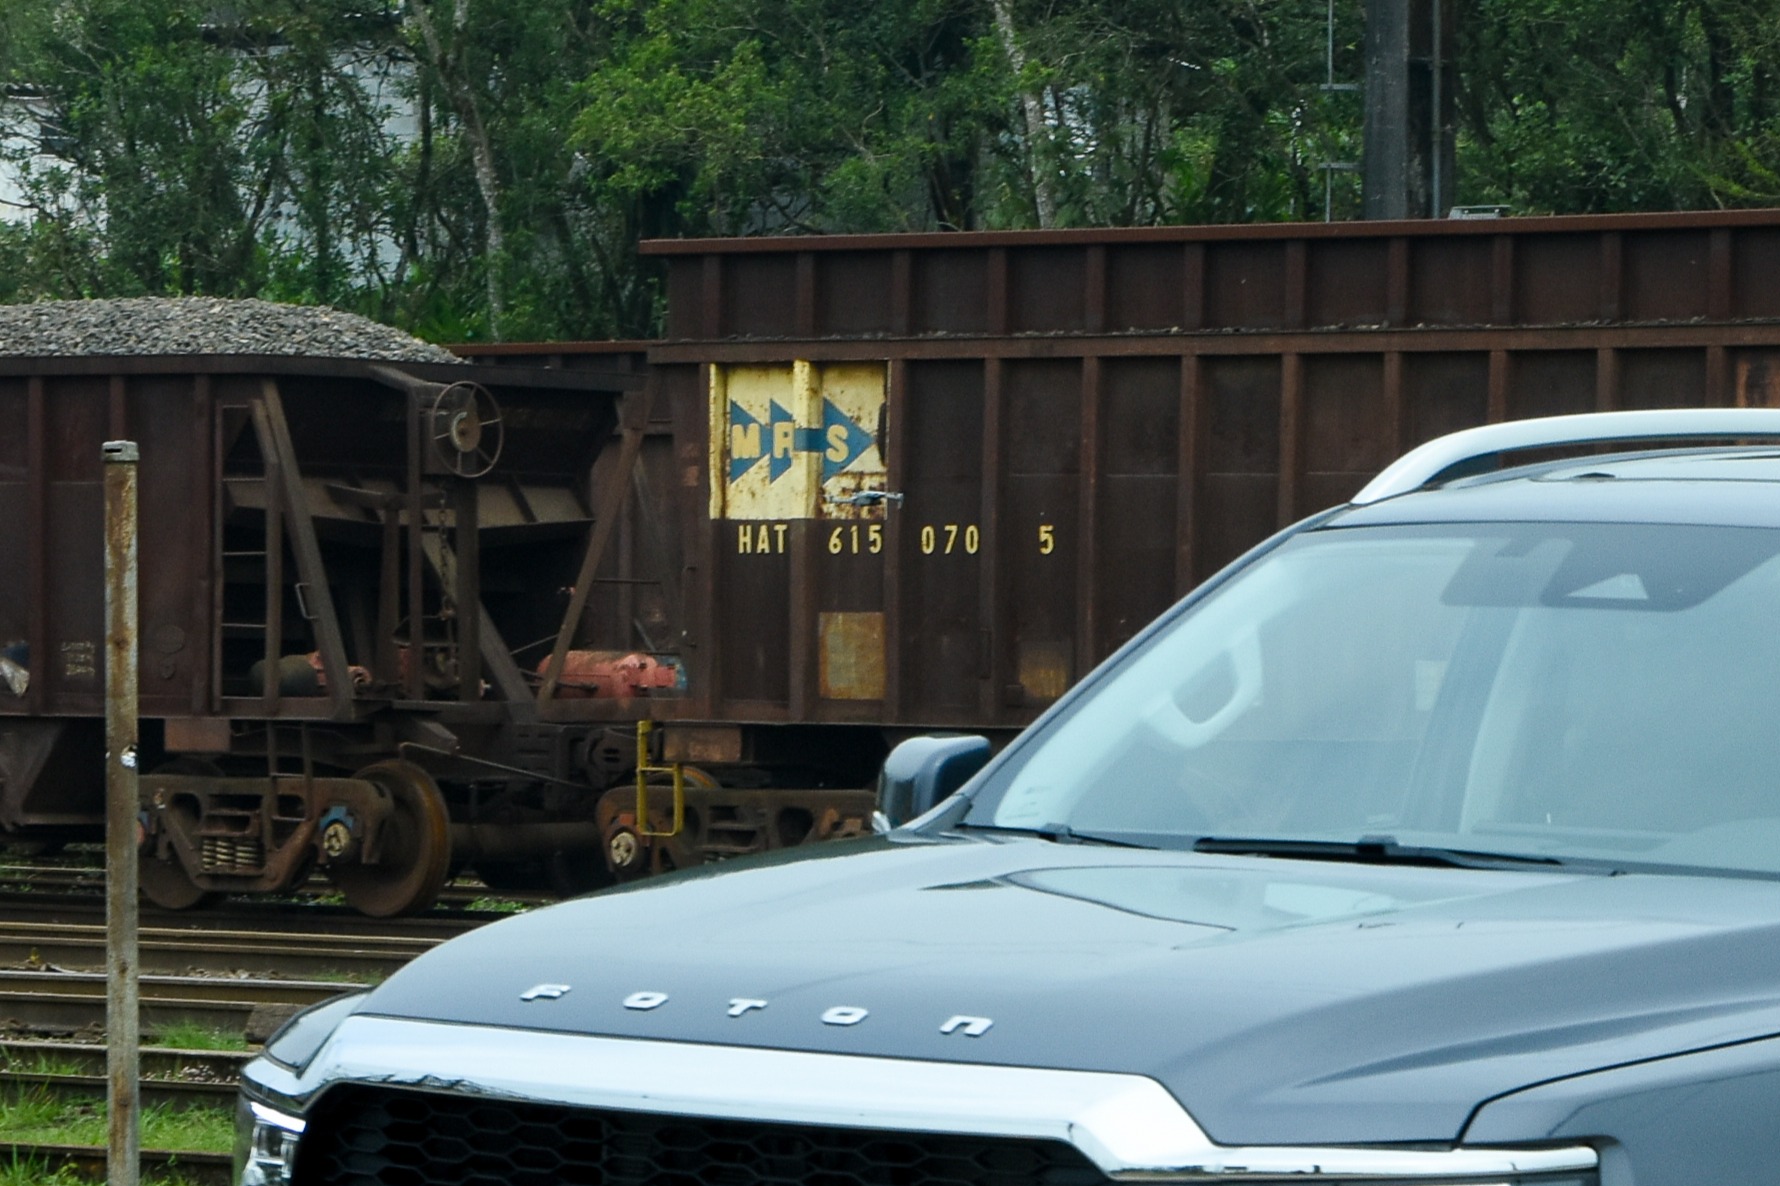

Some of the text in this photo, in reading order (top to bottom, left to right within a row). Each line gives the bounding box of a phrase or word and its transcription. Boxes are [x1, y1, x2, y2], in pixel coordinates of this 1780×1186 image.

[738, 523, 1055, 555] HAT 615 070 5
[519, 983, 994, 1037] FOTON
